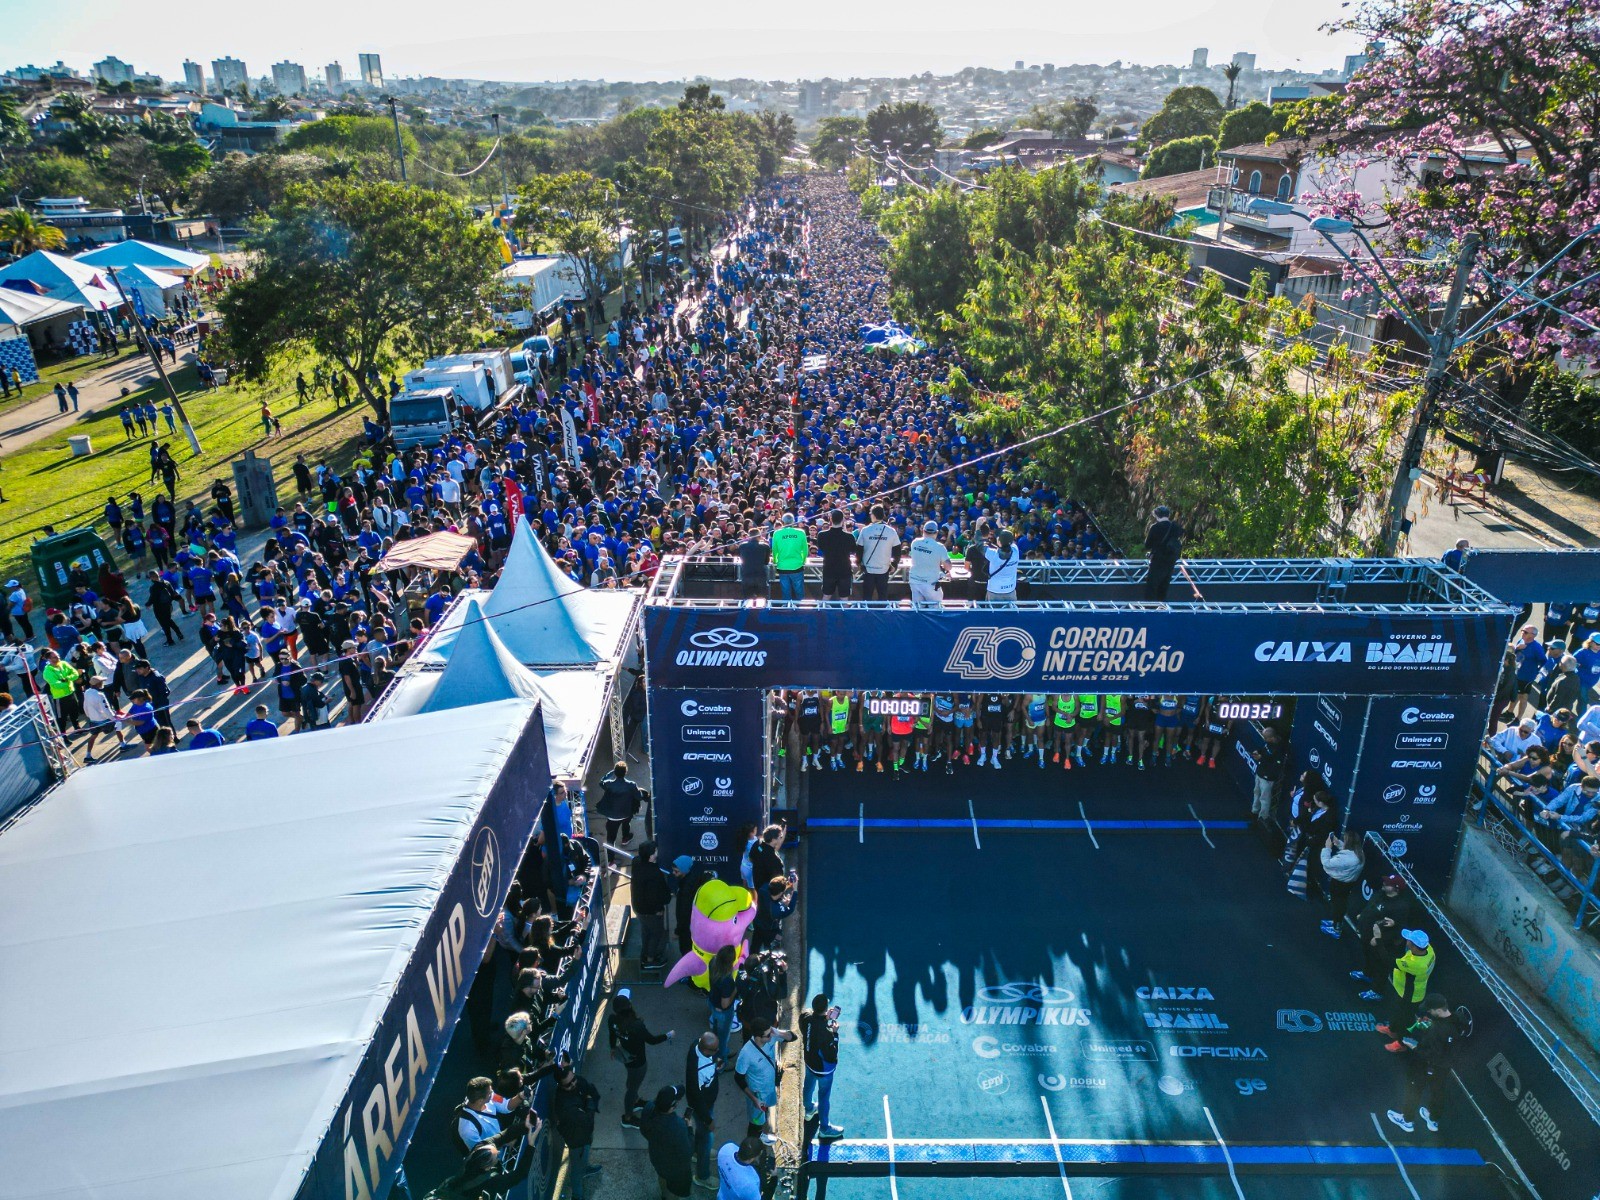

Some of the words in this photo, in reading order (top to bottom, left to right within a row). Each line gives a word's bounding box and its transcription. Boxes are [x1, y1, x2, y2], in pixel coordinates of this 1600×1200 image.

[1049, 626, 1148, 649] CORRIDA
[676, 650, 768, 667] OLYMPIKUS
[1254, 641, 1352, 662] CAIXA
[1365, 642, 1457, 664] BRASIL
[1042, 646, 1184, 677] INTEGRAÇÃO
[684, 781, 700, 792] EPTV
[1385, 788, 1404, 800] EPTV
[1136, 986, 1214, 1000] CAIXA
[960, 1006, 1092, 1026] OLYMPIKUS
[1143, 1012, 1229, 1028] BRASIL
[1325, 1012, 1376, 1022] CORRIDA
[879, 1024, 928, 1033] CORRIDA
[344, 1004, 428, 1200] ÁREA
[426, 902, 466, 1032] VIP
[1002, 1044, 1057, 1052] Covabra
[1090, 1044, 1132, 1052] Unimed
[1170, 1046, 1268, 1058] OFICINA
[982, 1074, 1004, 1090] EPTV
[1235, 1078, 1268, 1096] ge
[1524, 1090, 1562, 1142] CORRIDA
[1518, 1099, 1570, 1170] INTEGRAÇÃO
